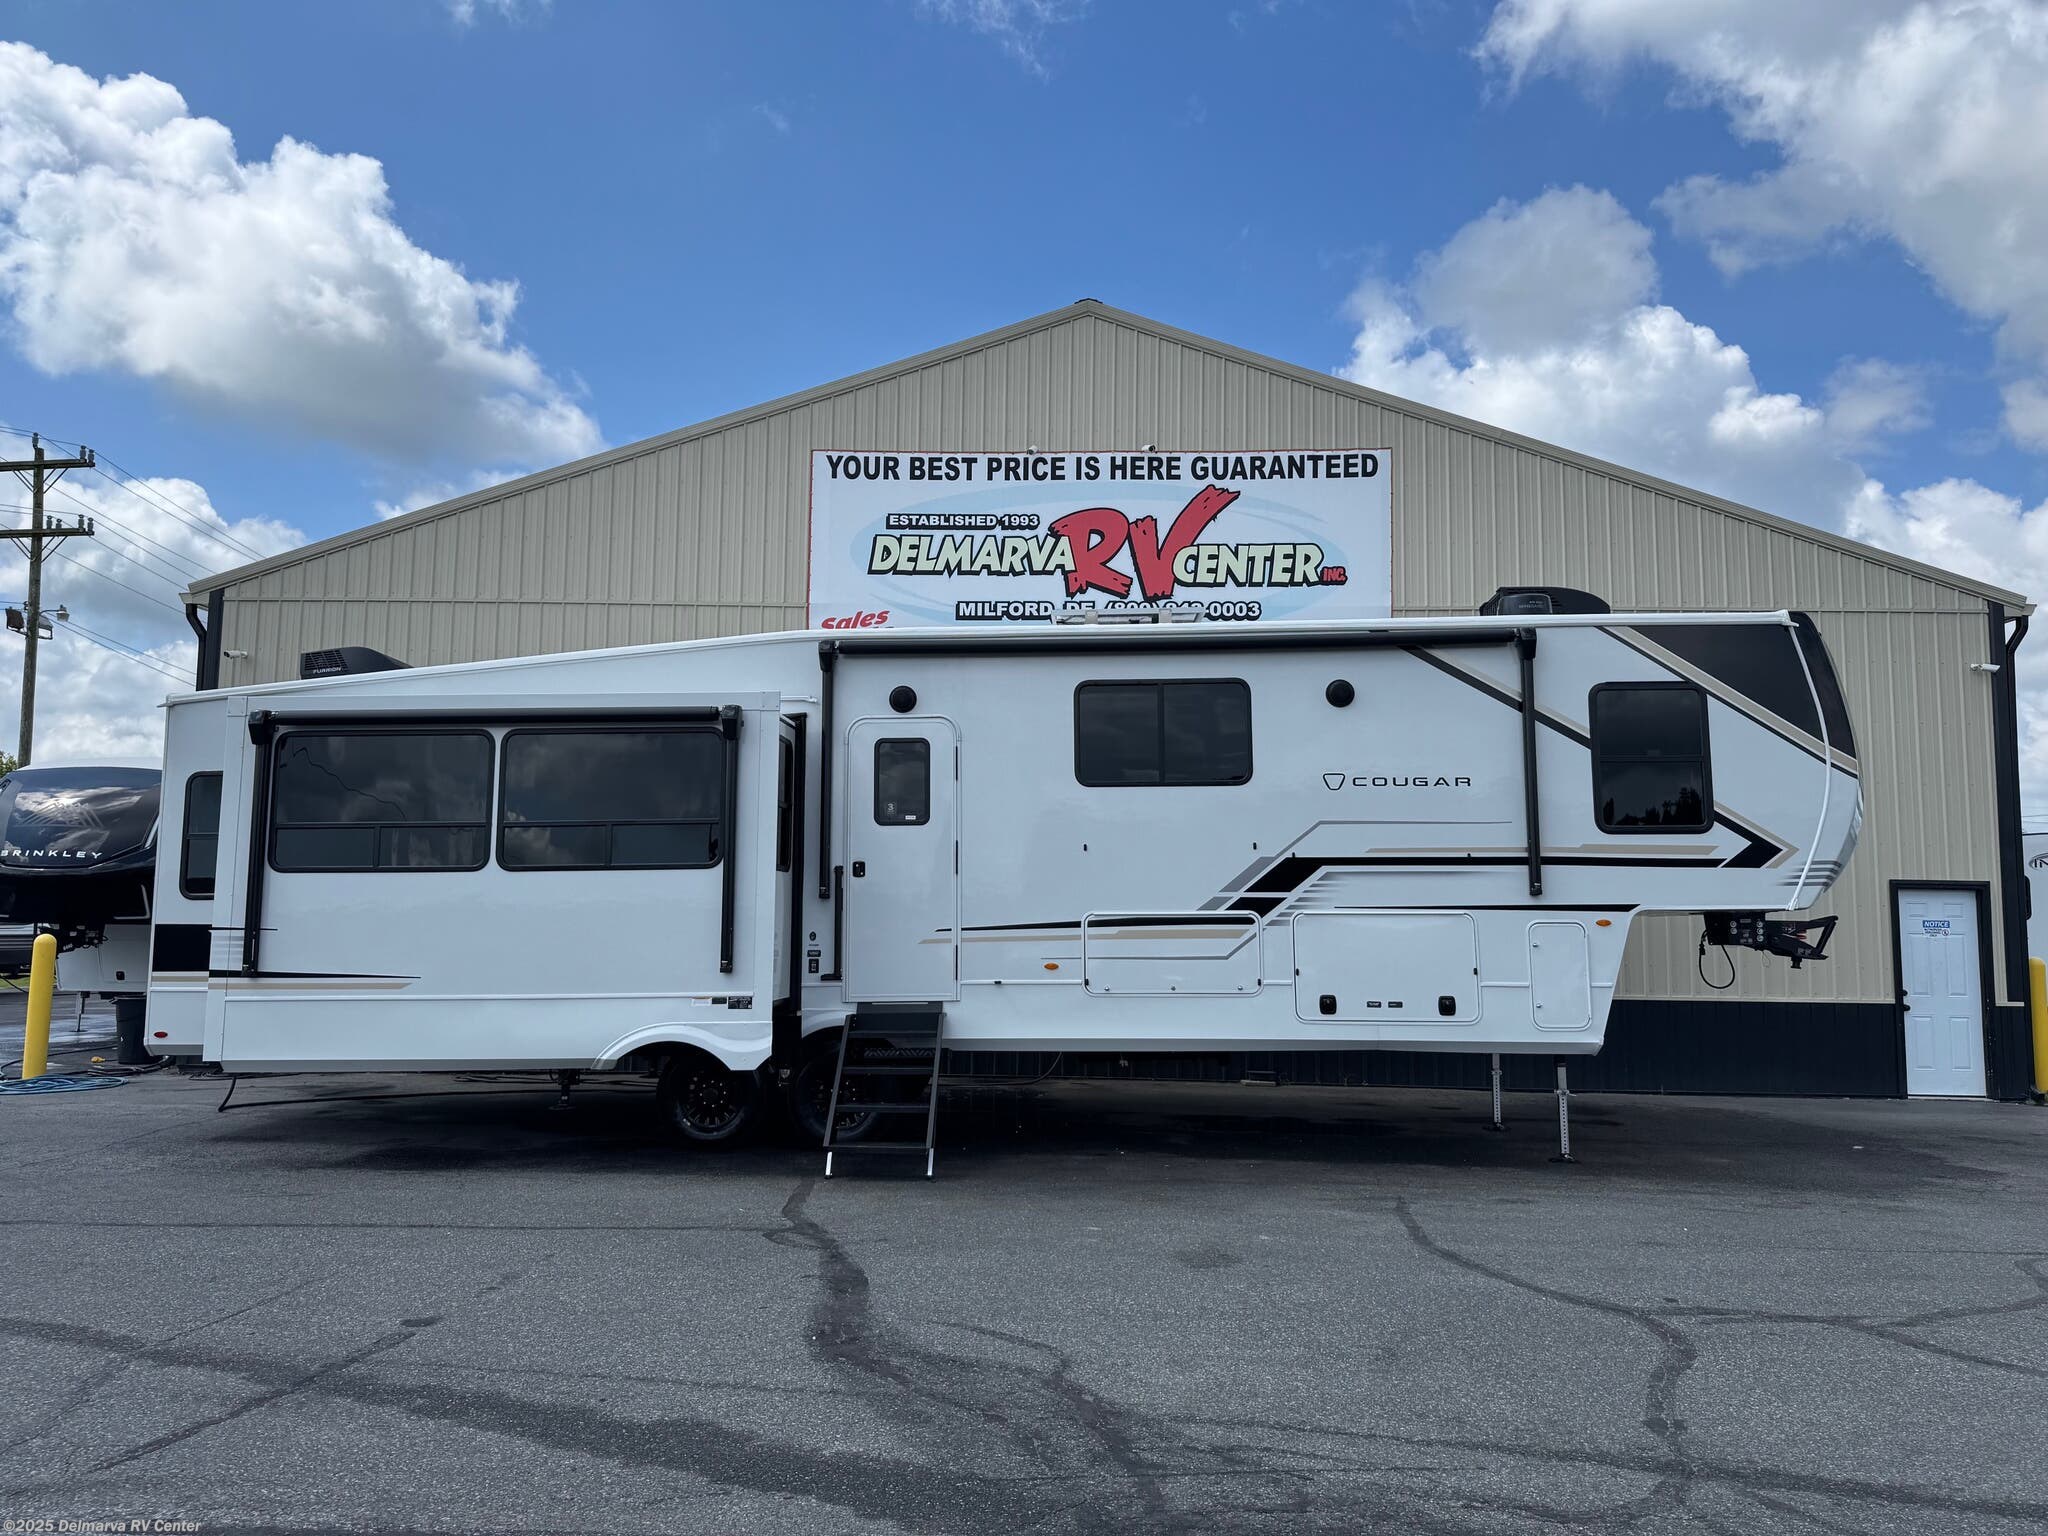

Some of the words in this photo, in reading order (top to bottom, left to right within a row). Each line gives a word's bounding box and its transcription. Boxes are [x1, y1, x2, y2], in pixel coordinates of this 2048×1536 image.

[826, 455, 900, 480] YOUR
[909, 456, 978, 481] BEST
[987, 456, 1066, 481] PRICE
[1075, 456, 1100, 481] IS
[1109, 456, 1181, 480] HERE
[1191, 454, 1379, 480] GUARANTEED
[889, 515, 997, 526] ESTABLISHED
[1002, 515, 1039, 526] 1993
[868, 534, 1077, 575] DELMARVA
[1048, 485, 1240, 600] RV
[1172, 544, 1323, 585] CENTER
[1352, 777, 1472, 787] COUGAR
[0, 849, 102, 859] BRINKLEY
